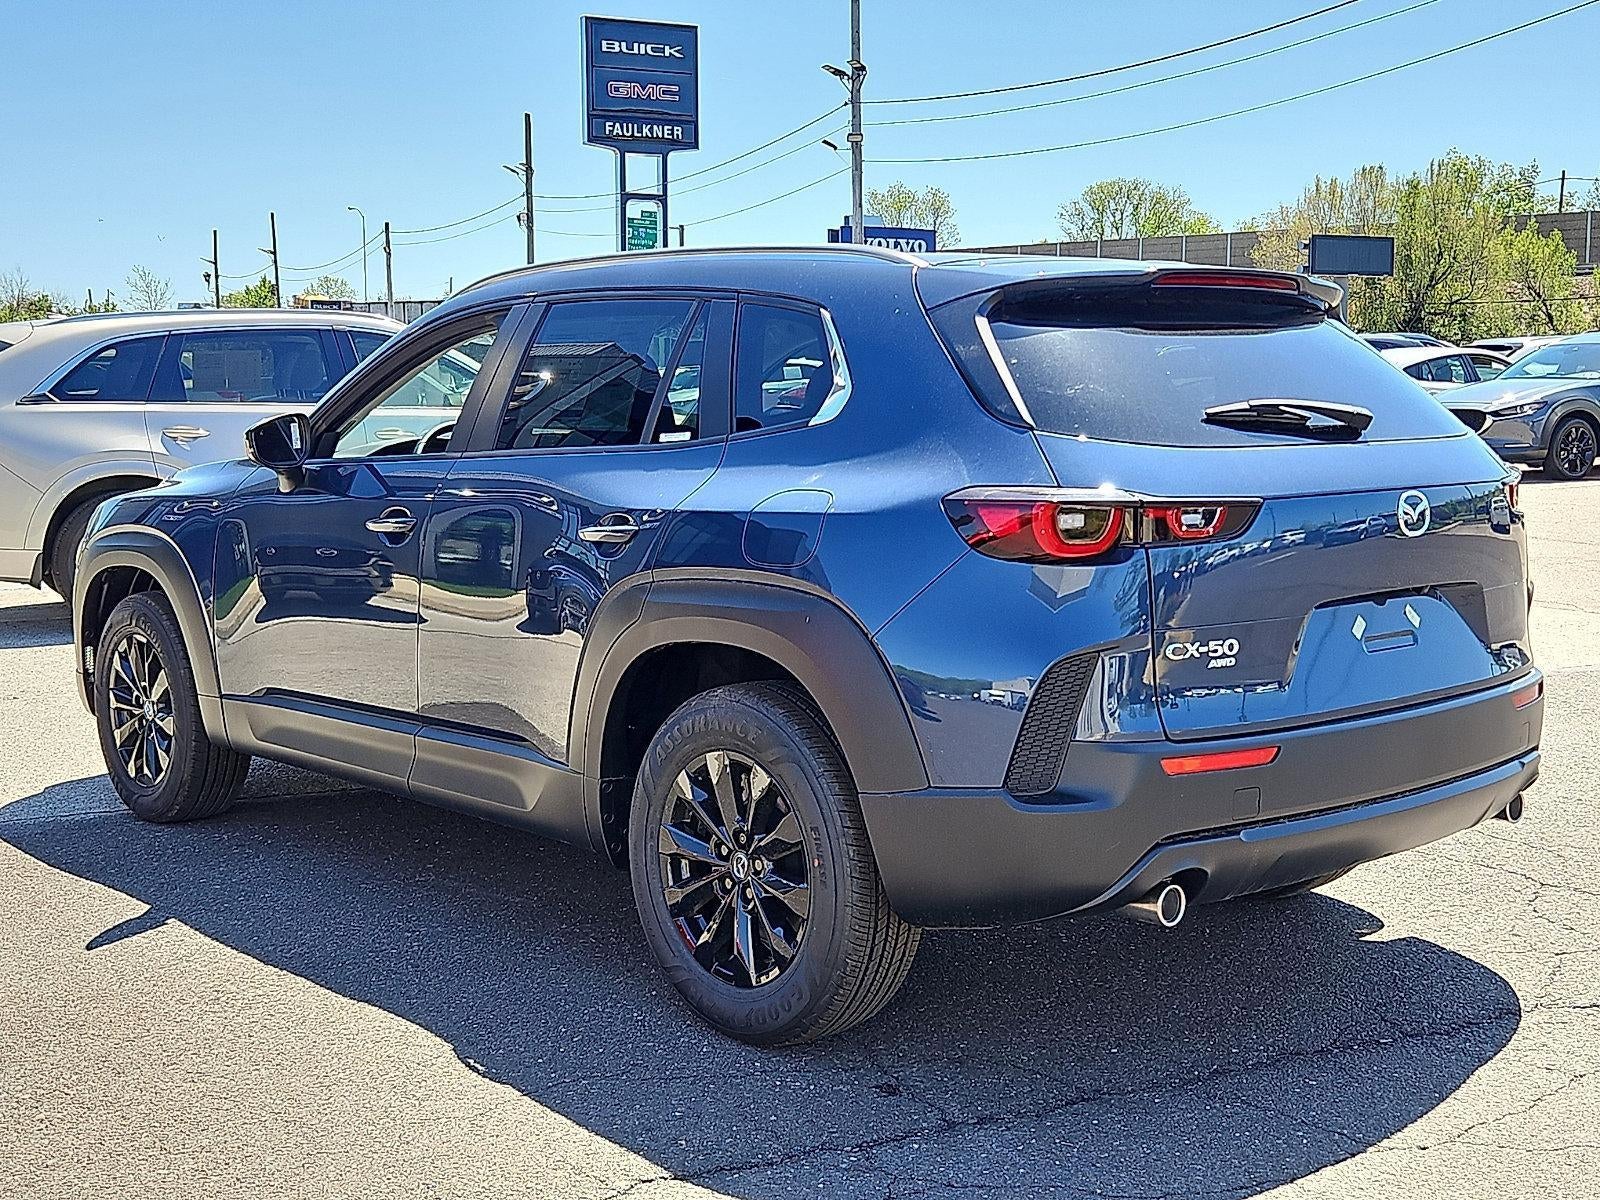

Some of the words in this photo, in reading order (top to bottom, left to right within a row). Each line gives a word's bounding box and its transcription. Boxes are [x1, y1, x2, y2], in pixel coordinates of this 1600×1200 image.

[601, 40, 684, 58] BUICK
[607, 81, 679, 101] GMC
[605, 121, 682, 139] FAULKNER
[1165, 638, 1240, 660] CX-50
[1207, 657, 1236, 669] AWD
[655, 711, 762, 766] ASSURANCE
